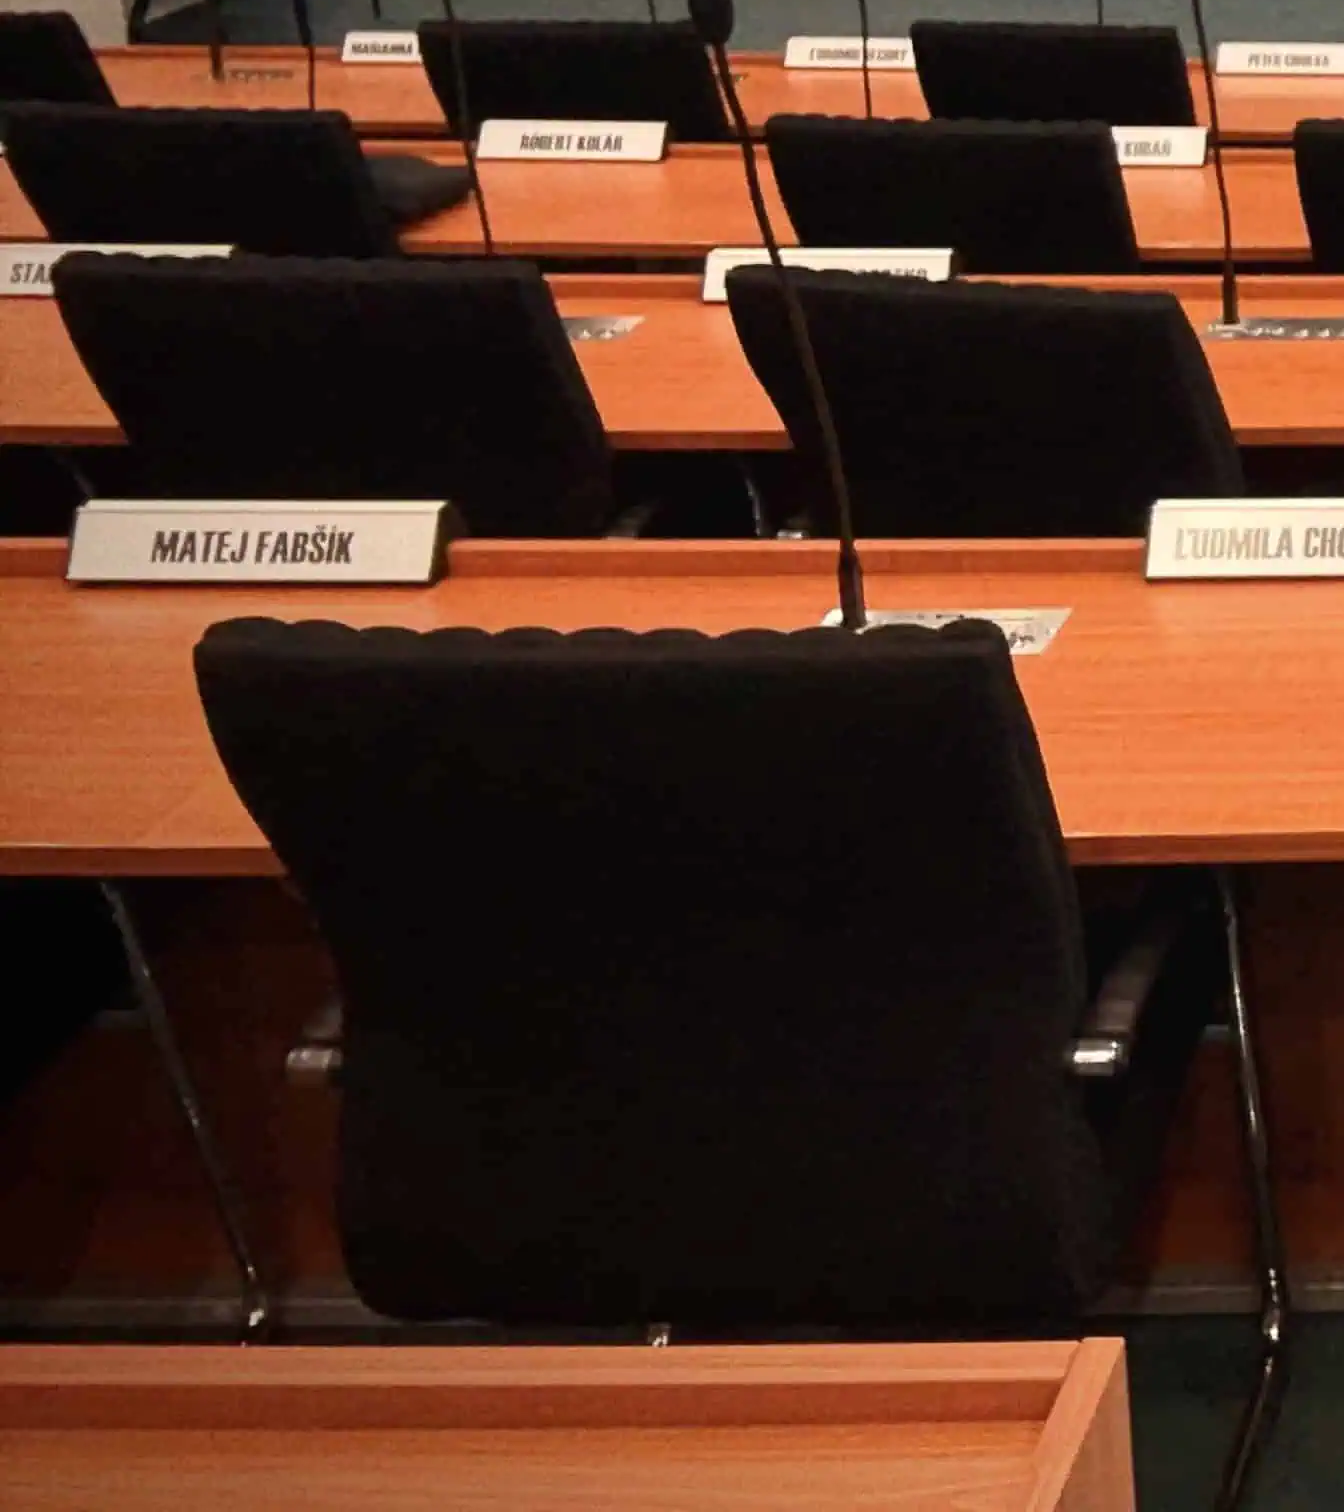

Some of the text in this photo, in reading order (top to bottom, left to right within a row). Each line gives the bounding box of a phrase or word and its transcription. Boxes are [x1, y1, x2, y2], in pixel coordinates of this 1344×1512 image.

[151, 523, 355, 565] MATEJ FABŠÍK
[1174, 526, 1294, 560] ĽUDMILA
